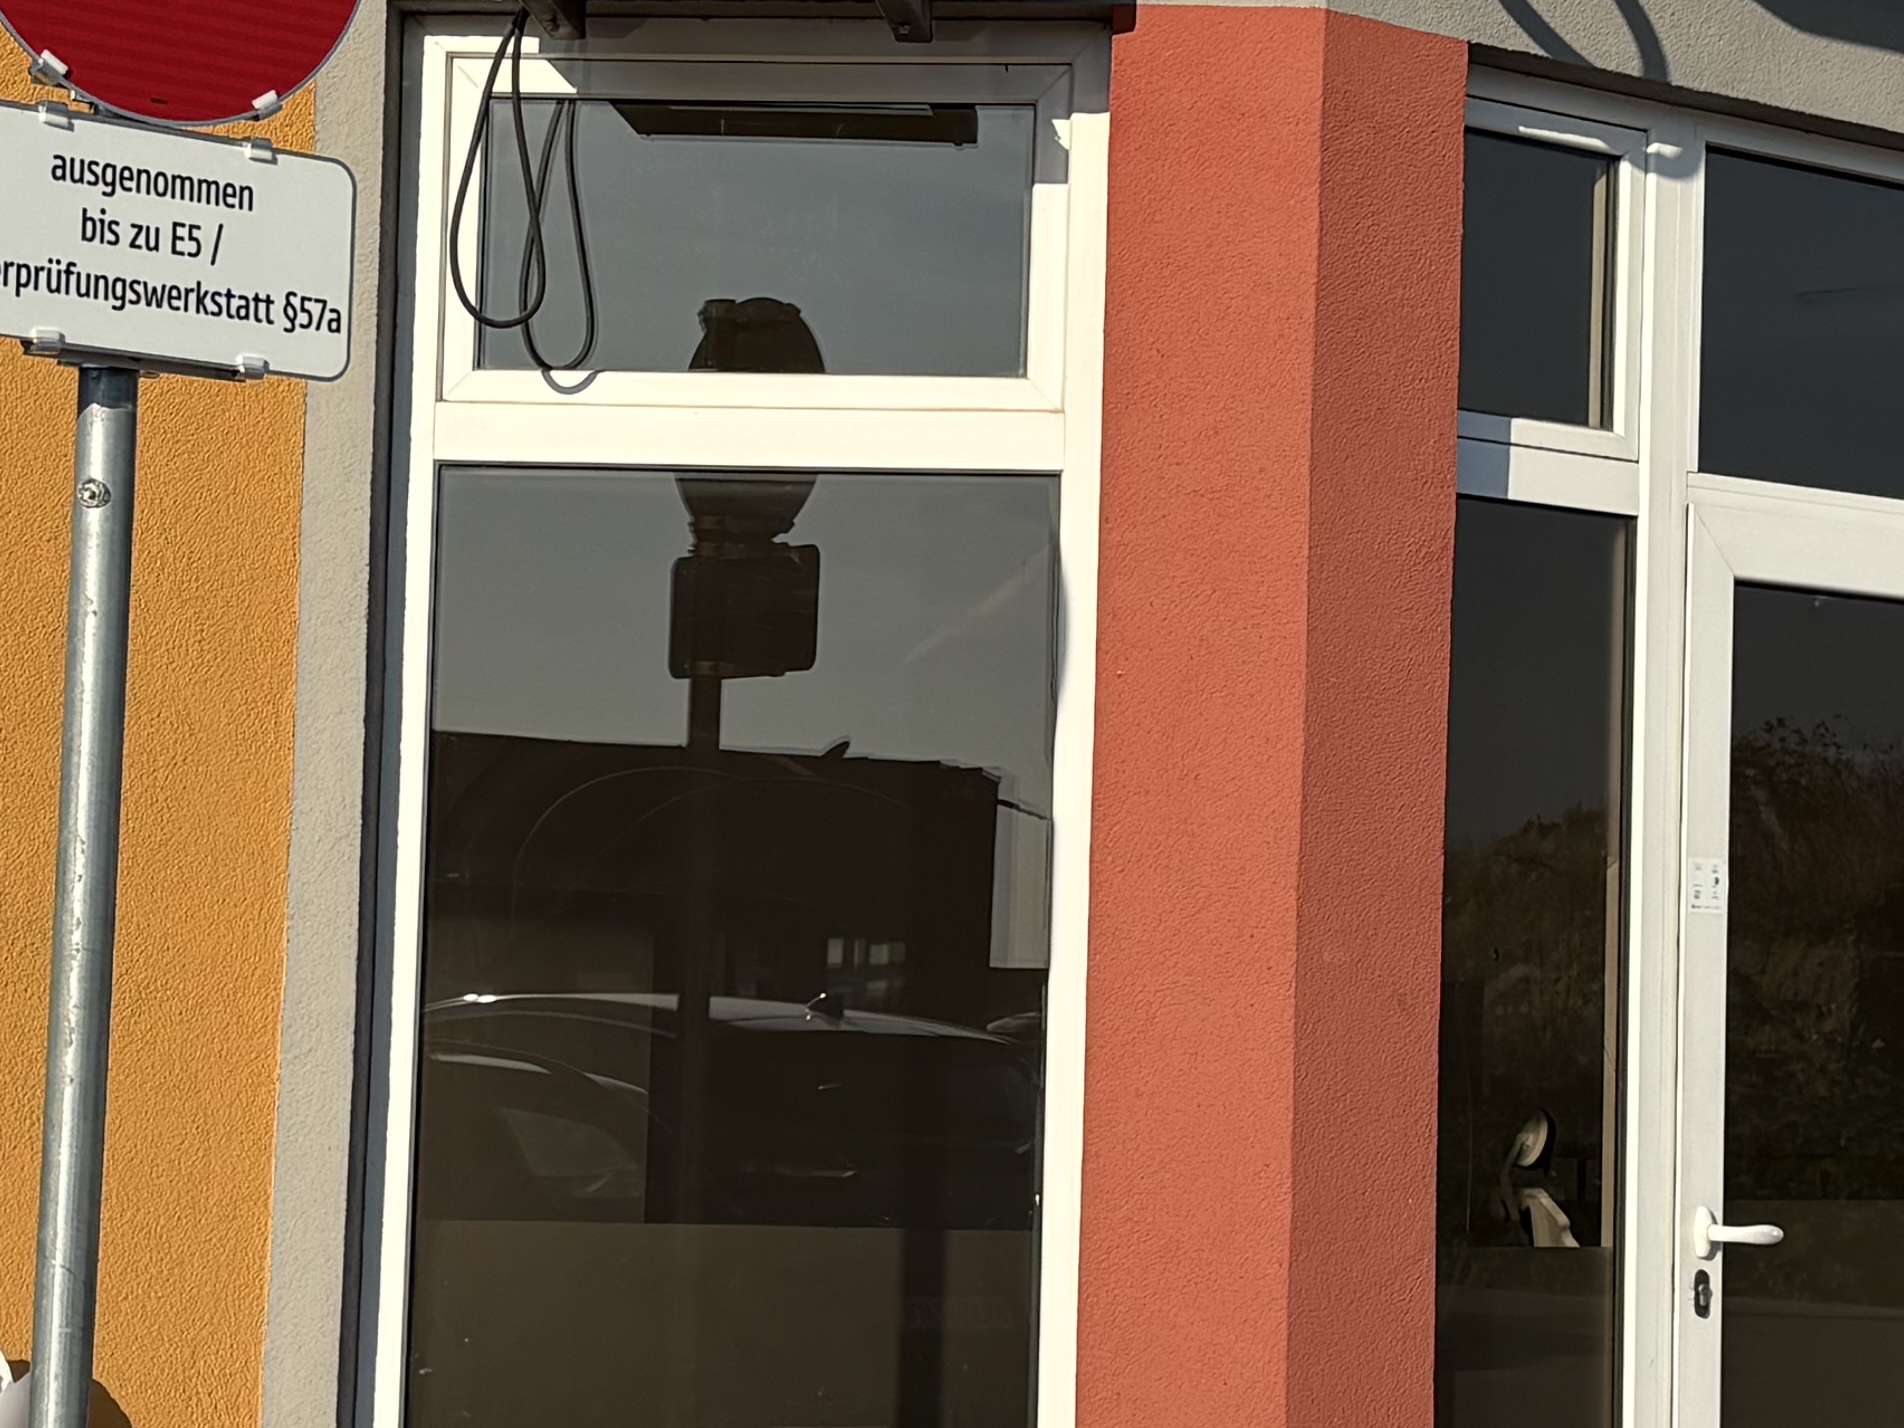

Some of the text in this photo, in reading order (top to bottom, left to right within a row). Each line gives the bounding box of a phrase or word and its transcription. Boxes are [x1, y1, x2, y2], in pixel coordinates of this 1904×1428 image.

[50, 153, 255, 212] ausgenommen
[80, 207, 225, 266] bis zu E5 /
[282, 290, 342, 334] §57a
